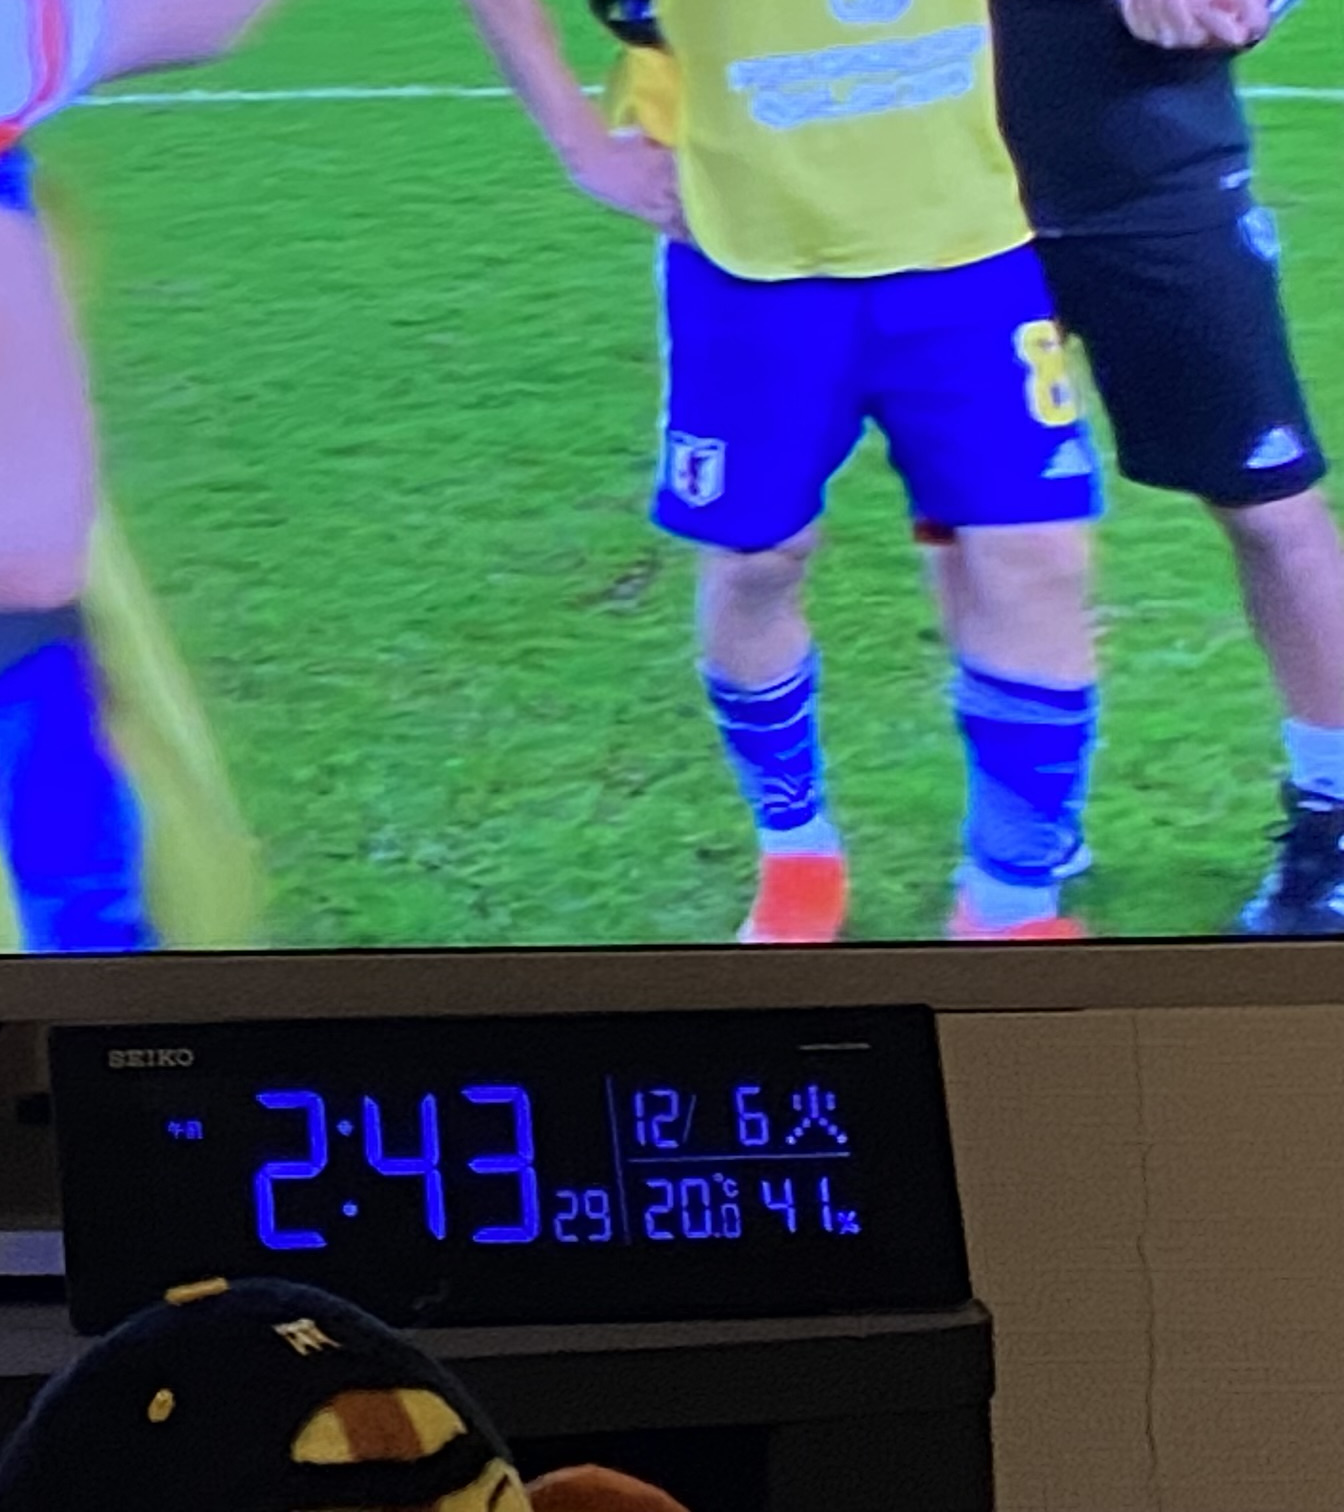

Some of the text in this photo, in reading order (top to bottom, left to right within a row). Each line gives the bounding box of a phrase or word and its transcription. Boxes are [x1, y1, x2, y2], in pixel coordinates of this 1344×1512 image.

[108, 1048, 194, 1069] SEIKO
[255, 1086, 541, 1250] 2:43
[553, 1188, 611, 1242] 29
